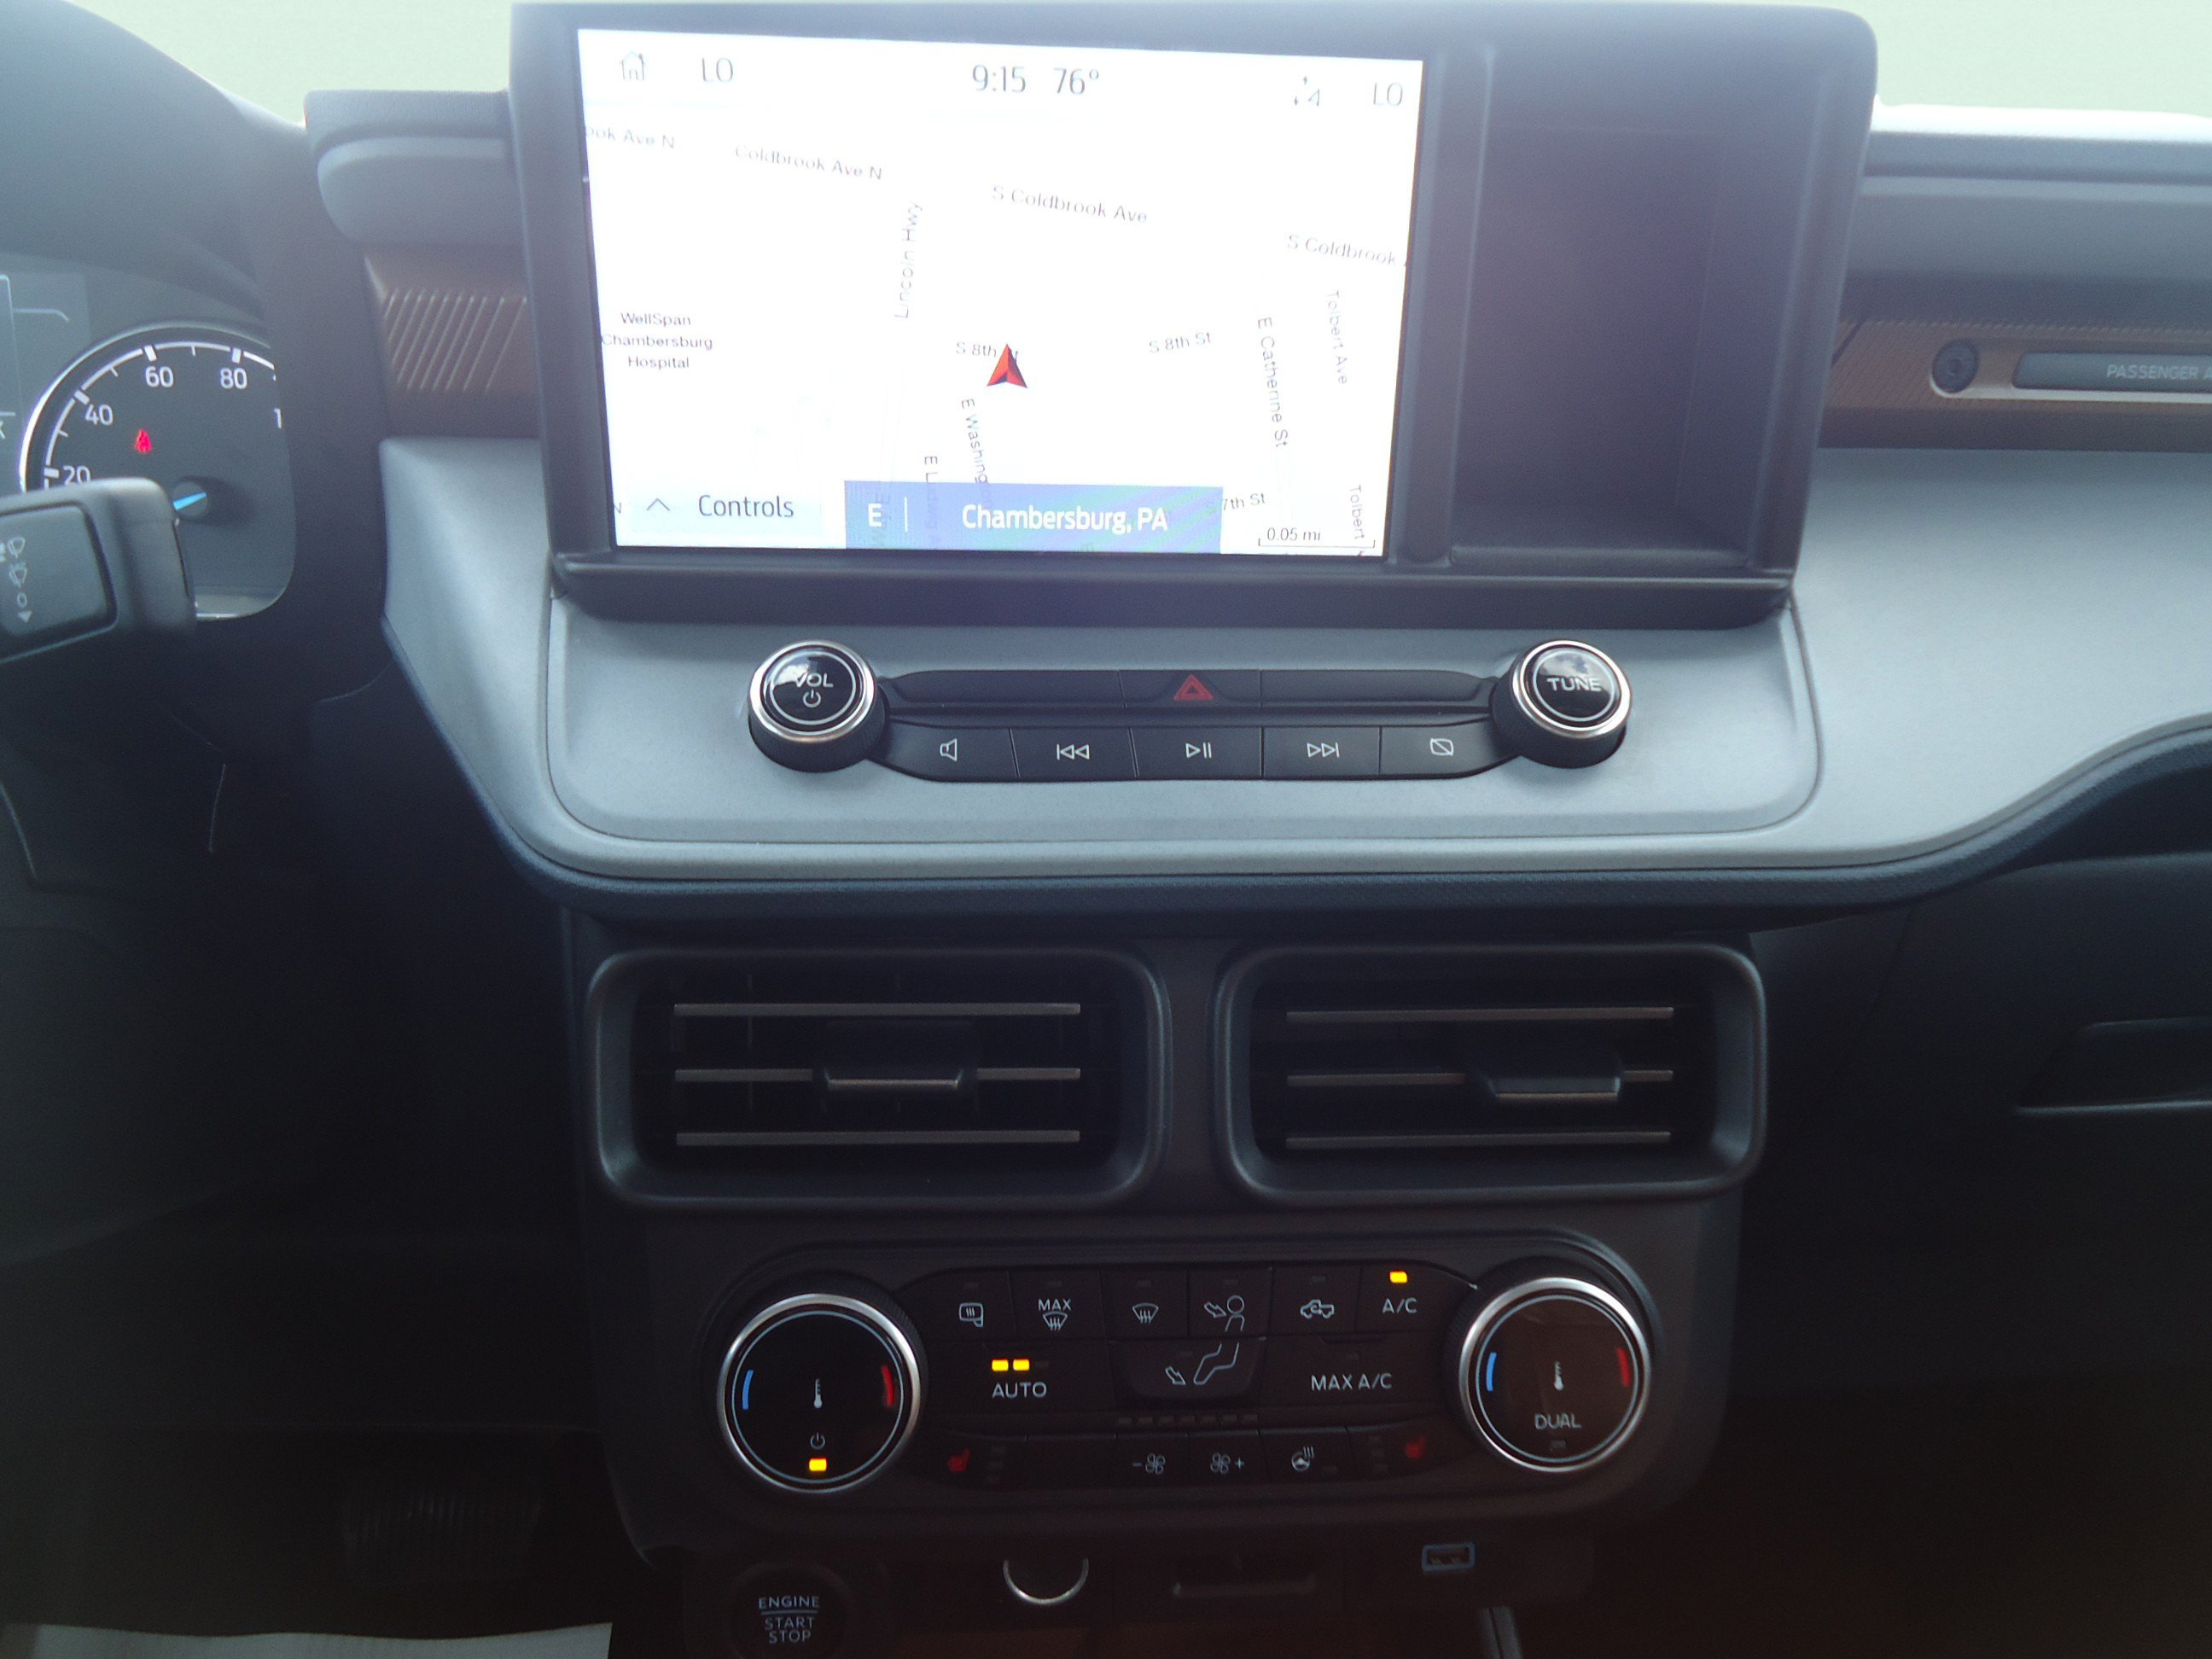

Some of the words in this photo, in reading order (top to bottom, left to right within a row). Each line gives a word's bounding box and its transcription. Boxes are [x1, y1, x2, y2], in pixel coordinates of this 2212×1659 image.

[701, 57, 734, 83] LO
[971, 64, 1027, 93] 9:15
[1372, 81, 1404, 107] LO
[623, 129, 655, 146] Ave
[661, 134, 676, 149] N
[734, 144, 825, 172] Coldbrook
[831, 160, 863, 177] Ave
[869, 166, 882, 181] N
[992, 184, 1004, 201] S
[1010, 188, 1106, 218] Coldbrook
[1113, 205, 1147, 224] Ave
[1287, 234, 1299, 249] S
[1305, 236, 1396, 265] Coldbrook
[620, 312, 692, 328] WellSpan
[602, 333, 713, 351] Chambersburg
[955, 341, 966, 355] S
[971, 343, 997, 358] 8th
[1149, 341, 1161, 354] S
[1165, 335, 1190, 351] 8th
[1196, 332, 1212, 346] St
[627, 355, 690, 370] Hospital
[145, 366, 174, 388] 60
[219, 367, 248, 389] 80
[2106, 364, 2199, 381] PASSENGER
[1257, 317, 1273, 329] E
[1274, 428, 1289, 448] St
[961, 398, 975, 410] E
[84, 404, 114, 426] 40
[924, 455, 939, 465] E
[62, 465, 91, 486] 20
[697, 495, 795, 519] Controls
[1249, 492, 1266, 506] St
[867, 503, 882, 527] E
[961, 504, 1132, 535] Chambersburg,
[1137, 507, 1168, 532] PA
[1266, 527, 1298, 542] 0.05
[1302, 527, 1321, 542] mi
[795, 672, 834, 688] VOL
[1546, 676, 1602, 692] TUNE
[1038, 1298, 1072, 1311] MAX
[1382, 1298, 1417, 1314] A/C
[992, 1382, 1048, 1399] AUTO
[1311, 1374, 1353, 1391] MAX
[1359, 1373, 1393, 1389] A/C
[1534, 1413, 1582, 1430] DUAL
[758, 1596, 820, 1610] ENGINE
[765, 1617, 815, 1630] START
[768, 1629, 812, 1644] STOP
